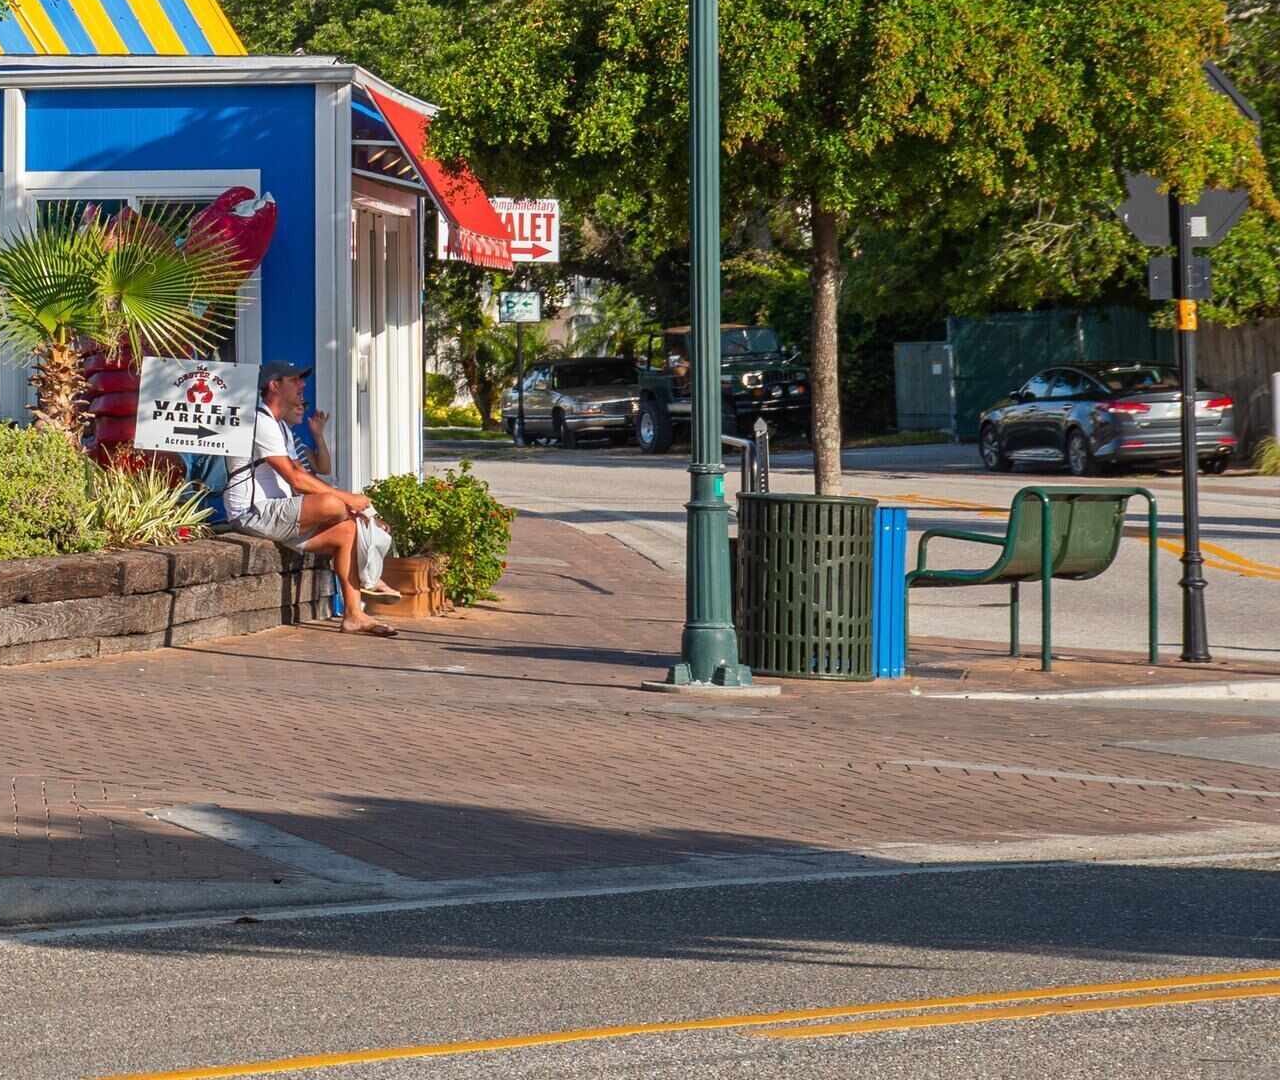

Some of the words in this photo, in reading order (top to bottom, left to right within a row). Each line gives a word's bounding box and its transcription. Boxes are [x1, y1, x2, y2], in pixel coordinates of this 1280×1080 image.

[496, 213, 555, 241] ALET
[173, 372, 210, 387] LOBSTER
[212, 376, 227, 389] POT
[154, 400, 241, 416] VALET
[153, 410, 240, 427] PARKING
[165, 437, 194, 446] Across
[198, 440, 225, 448] Street
